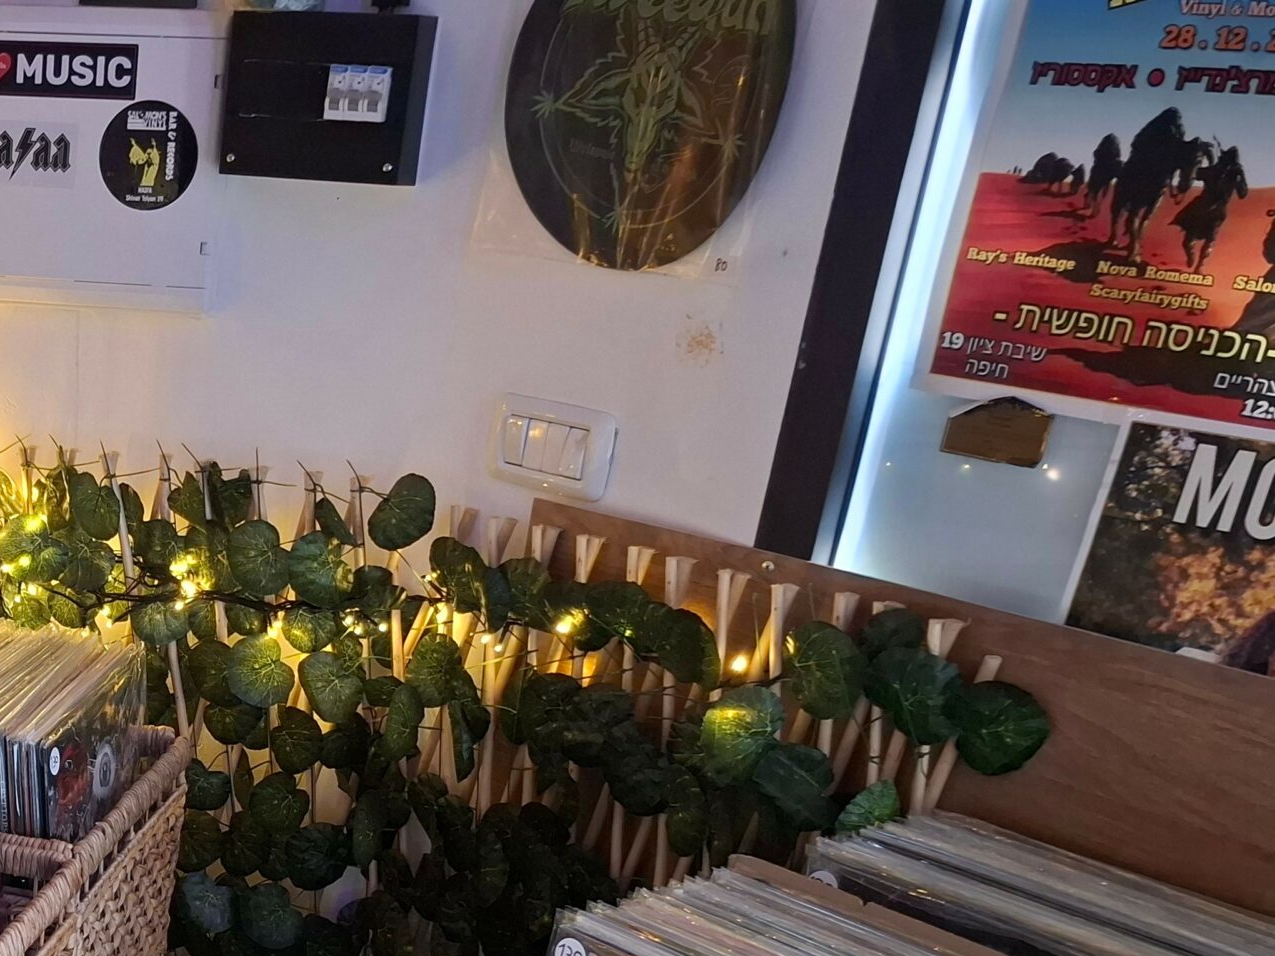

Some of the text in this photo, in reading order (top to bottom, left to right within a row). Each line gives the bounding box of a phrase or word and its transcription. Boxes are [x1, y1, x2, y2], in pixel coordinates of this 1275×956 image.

[1180, 0, 1224, 18] Vinyl
[15, 53, 132, 88] MUSIC
[967, 247, 1076, 271] Ray's Heritage
[1096, 259, 1213, 286] Nova Romema
[1089, 283, 1208, 310] Scaryfairygifts
[1014, 304, 1133, 344] חופשית
[941, 331, 1047, 361] שיבת ציון 19
[965, 358, 1010, 379] חיפה
